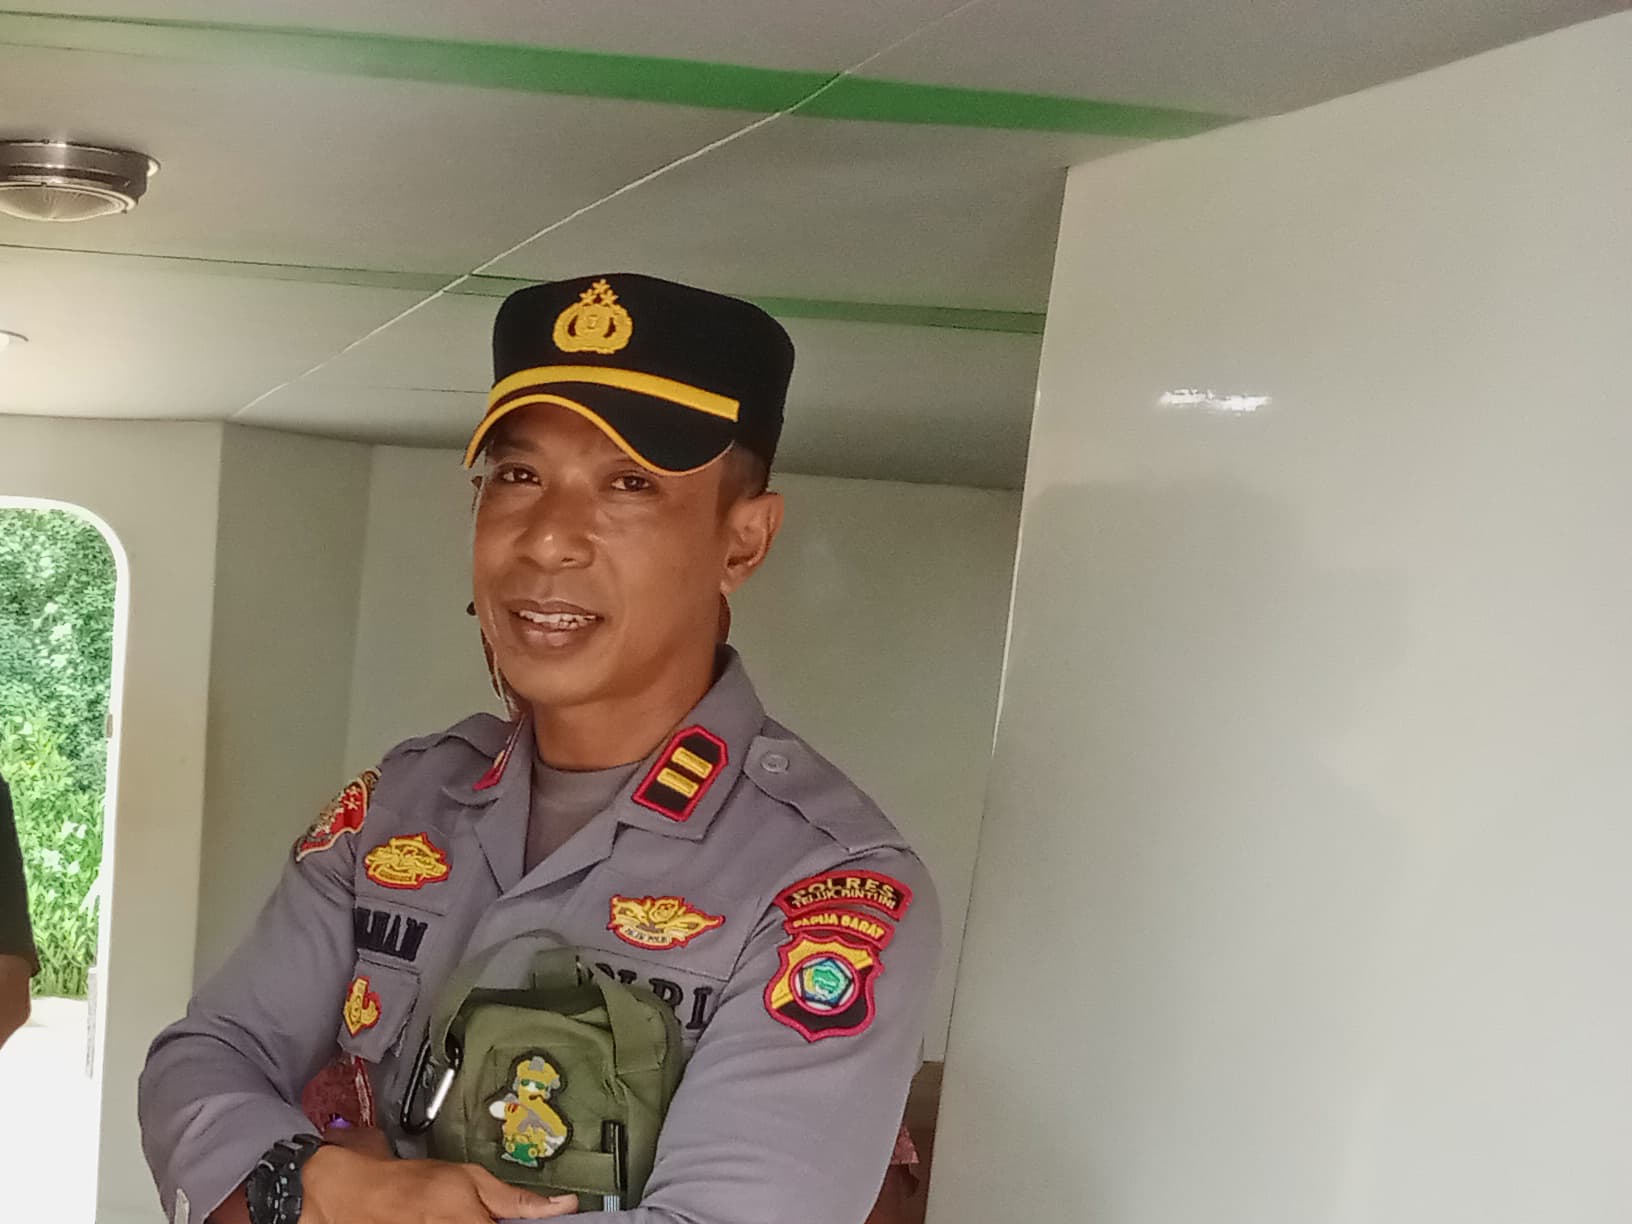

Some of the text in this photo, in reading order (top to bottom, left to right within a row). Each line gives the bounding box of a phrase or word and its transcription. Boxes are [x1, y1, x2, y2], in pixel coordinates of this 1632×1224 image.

[791, 877, 897, 900] POLRES
[792, 913, 885, 939] PAPUA BARAT
